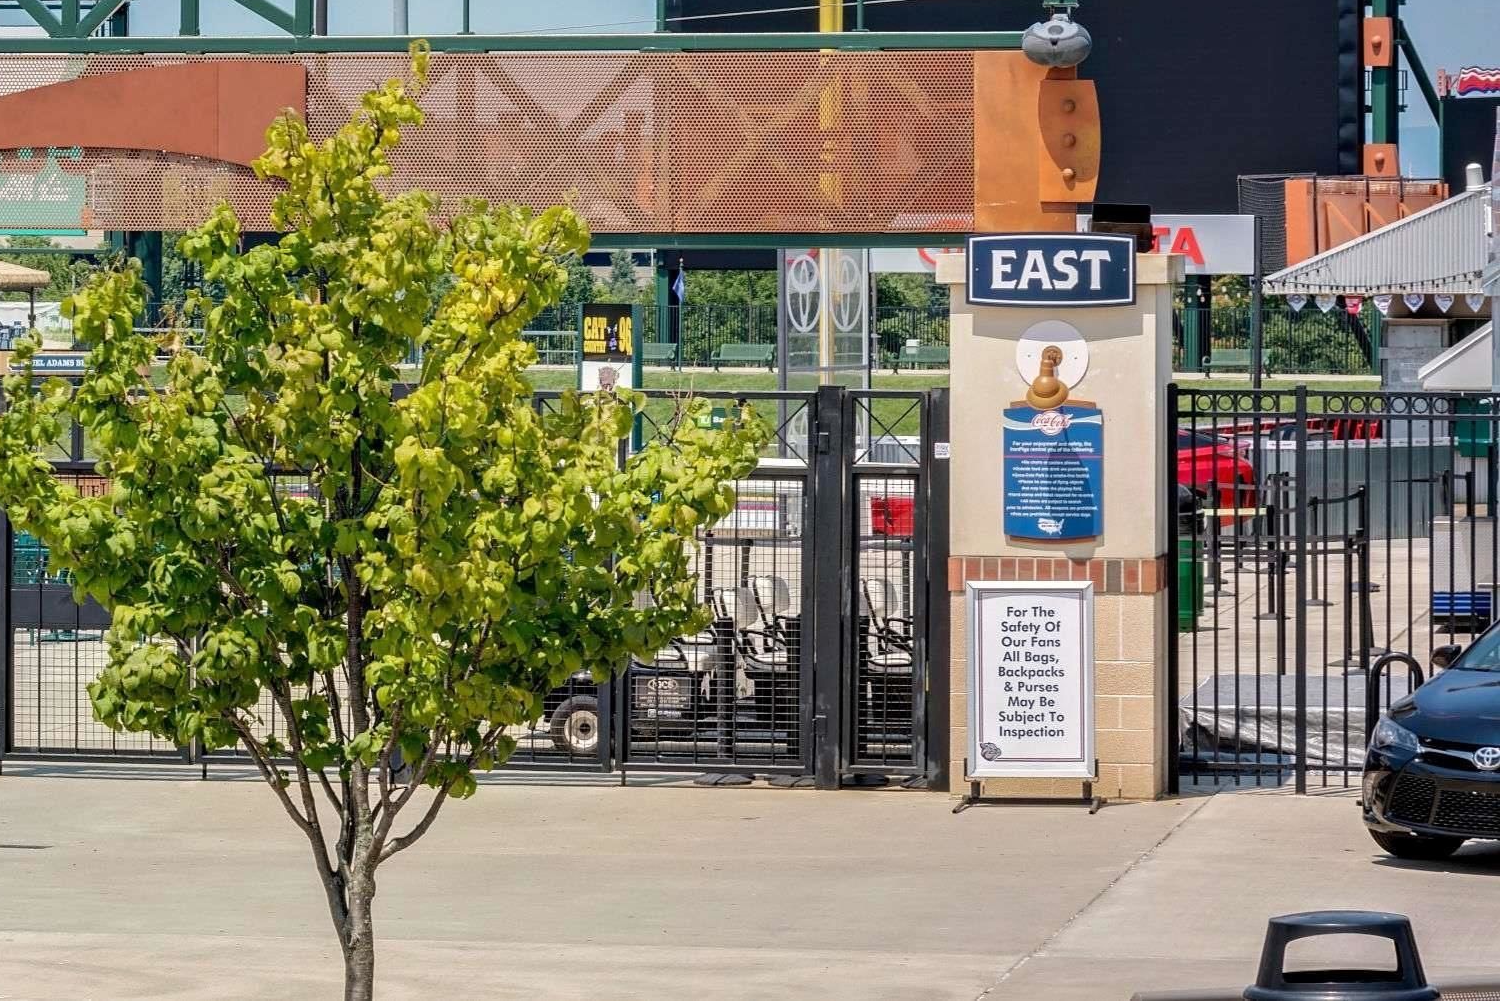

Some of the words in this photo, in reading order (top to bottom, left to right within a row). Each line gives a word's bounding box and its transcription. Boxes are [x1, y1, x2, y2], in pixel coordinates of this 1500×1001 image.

[990, 249, 1111, 290] EAST
[1006, 606, 1028, 618] For
[1031, 605, 1055, 618] The
[1001, 620, 1041, 635] Safety
[1044, 620, 1061, 633] Of
[1001, 636, 1027, 648] Our
[1030, 636, 1061, 648] Fans
[1002, 650, 1020, 662] All
[1024, 651, 1059, 665] Bags,
[998, 665, 1065, 680] Backpacks
[1003, 681, 1013, 693] &
[1017, 681, 1059, 693] Purses
[1007, 696, 1036, 710] May
[1039, 696, 1056, 707] Be
[998, 710, 1045, 725] Subject
[1048, 711, 1065, 723] To
[999, 725, 1065, 740] Inspection
